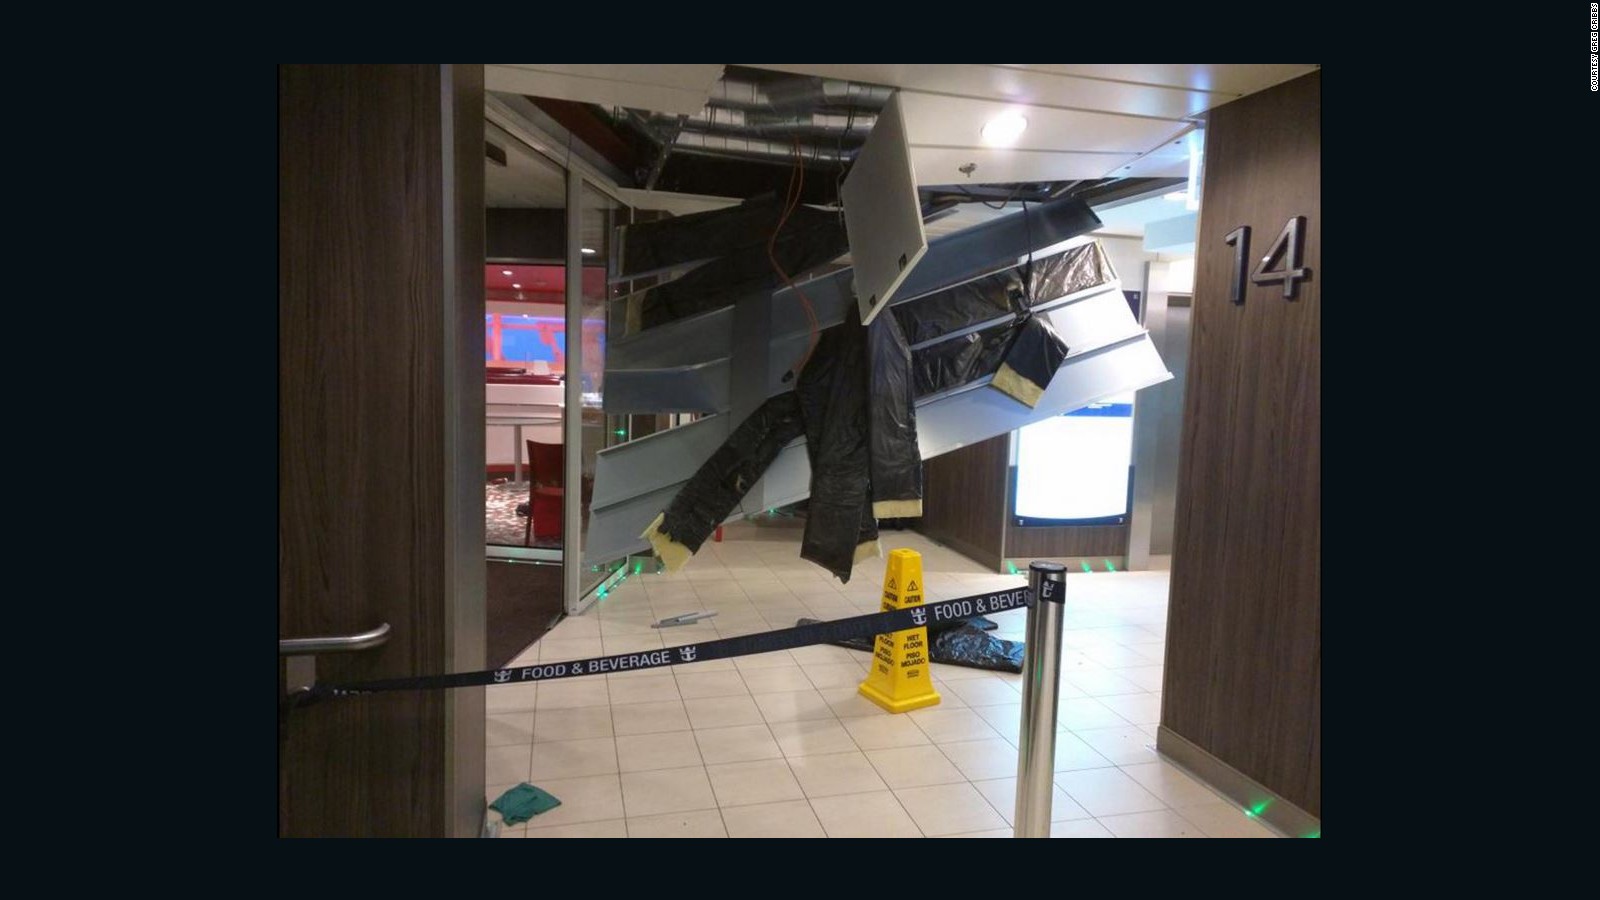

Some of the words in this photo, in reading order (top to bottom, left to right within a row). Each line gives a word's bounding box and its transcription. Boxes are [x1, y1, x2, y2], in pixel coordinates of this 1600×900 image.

[1225, 215, 1312, 305] 14
[904, 595, 921, 604] CAUTION
[934, 600, 972, 621] FOOD
[976, 598, 987, 613] &
[903, 641, 923, 650] FLOOR
[906, 651, 920, 659] PISO
[521, 664, 567, 680] FOOD
[571, 662, 584, 674] &
[588, 650, 671, 673] BEVERAGE
[901, 658, 925, 667] MOJADO
